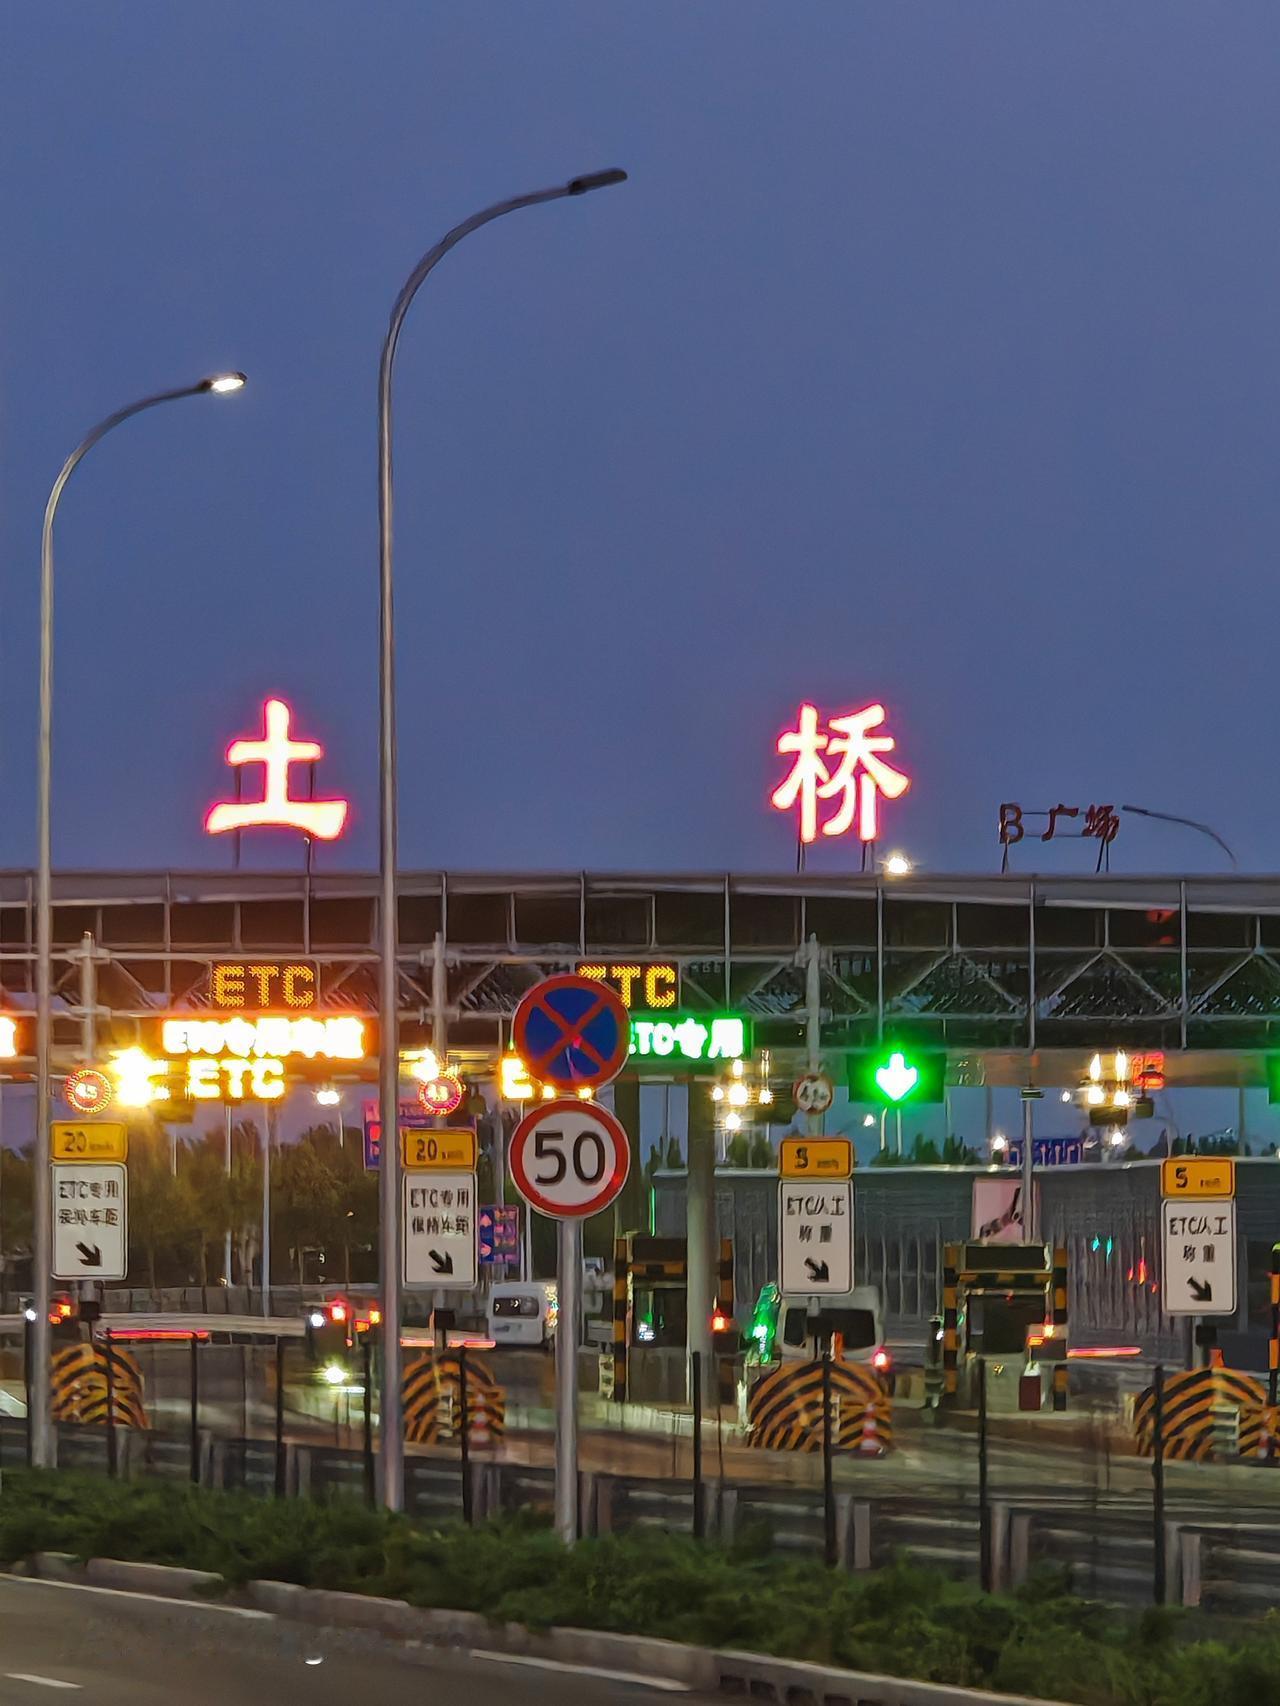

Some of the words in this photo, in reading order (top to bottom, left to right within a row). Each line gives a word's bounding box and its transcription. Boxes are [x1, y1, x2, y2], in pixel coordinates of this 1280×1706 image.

[204, 699, 349, 841] 土
[770, 702, 910, 843] 桥
[212, 965, 314, 1008] ETC
[578, 965, 676, 1008] TC
[188, 1057, 286, 1099] ETC
[63, 1131, 87, 1153] 20
[416, 1138, 438, 1161] 20
[534, 1130, 606, 1187] 50
[1175, 1167, 1188, 1188] 5
